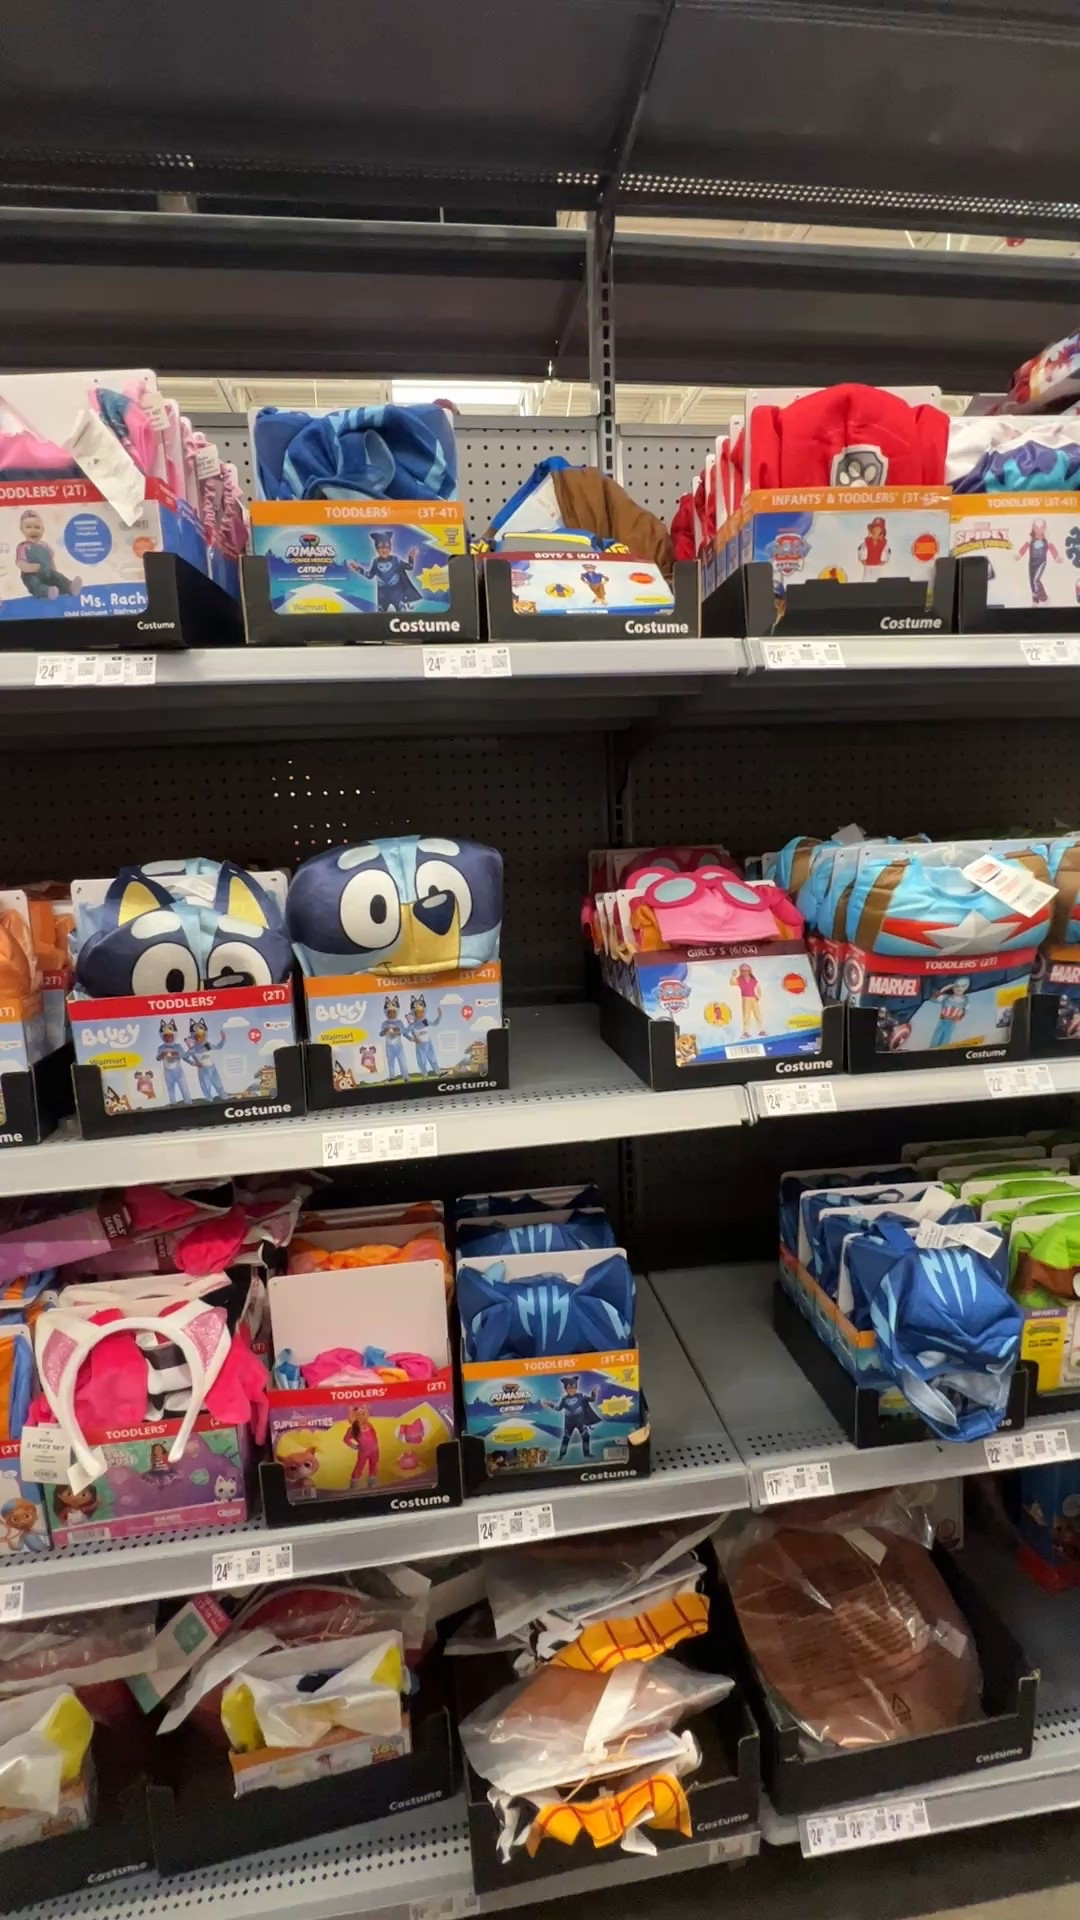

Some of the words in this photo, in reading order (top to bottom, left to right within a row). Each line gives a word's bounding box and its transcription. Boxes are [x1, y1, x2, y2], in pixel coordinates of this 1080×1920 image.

[62, 483, 87, 498] (2T)
[771, 494, 824, 506] INFANTS'
[827, 495, 835, 504] &
[838, 492, 898, 505] TODDLERS'
[324, 507, 390, 518] TODDLERS'
[418, 507, 458, 518] (3T-4T)
[955, 528, 1009, 543] SPIDEY
[300, 545, 336, 557] MASKS
[80, 594, 106, 608] Ms.
[137, 620, 175, 631] Costume
[389, 618, 461, 633] Costume
[625, 620, 689, 634] Costume
[879, 616, 942, 630] Costume
[925, 958, 978, 970] TODDLERS'
[375, 974, 436, 988] TODDLERS'
[868, 976, 918, 997] MARVEL
[148, 995, 217, 1011] TODDLERS'
[263, 989, 286, 1002] (2T)
[320, 1030, 355, 1041] Walmart
[965, 1048, 1007, 1060] Costume
[775, 1058, 833, 1074] Costume
[437, 1079, 497, 1093] Costume
[224, 1103, 292, 1119] Costume
[524, 1358, 578, 1371] TODDLERS'
[331, 1387, 388, 1401] TODDLERS'
[427, 1380, 447, 1392] (2T)
[106, 1423, 167, 1440] TODDLERS'
[580, 1468, 637, 1482] Costume
[390, 1494, 450, 1510] Costume
[976, 1746, 1024, 1764] Costume
[388, 1788, 444, 1812] Costume
[697, 1812, 750, 1832] Costume
[87, 1860, 148, 1885] Costume
